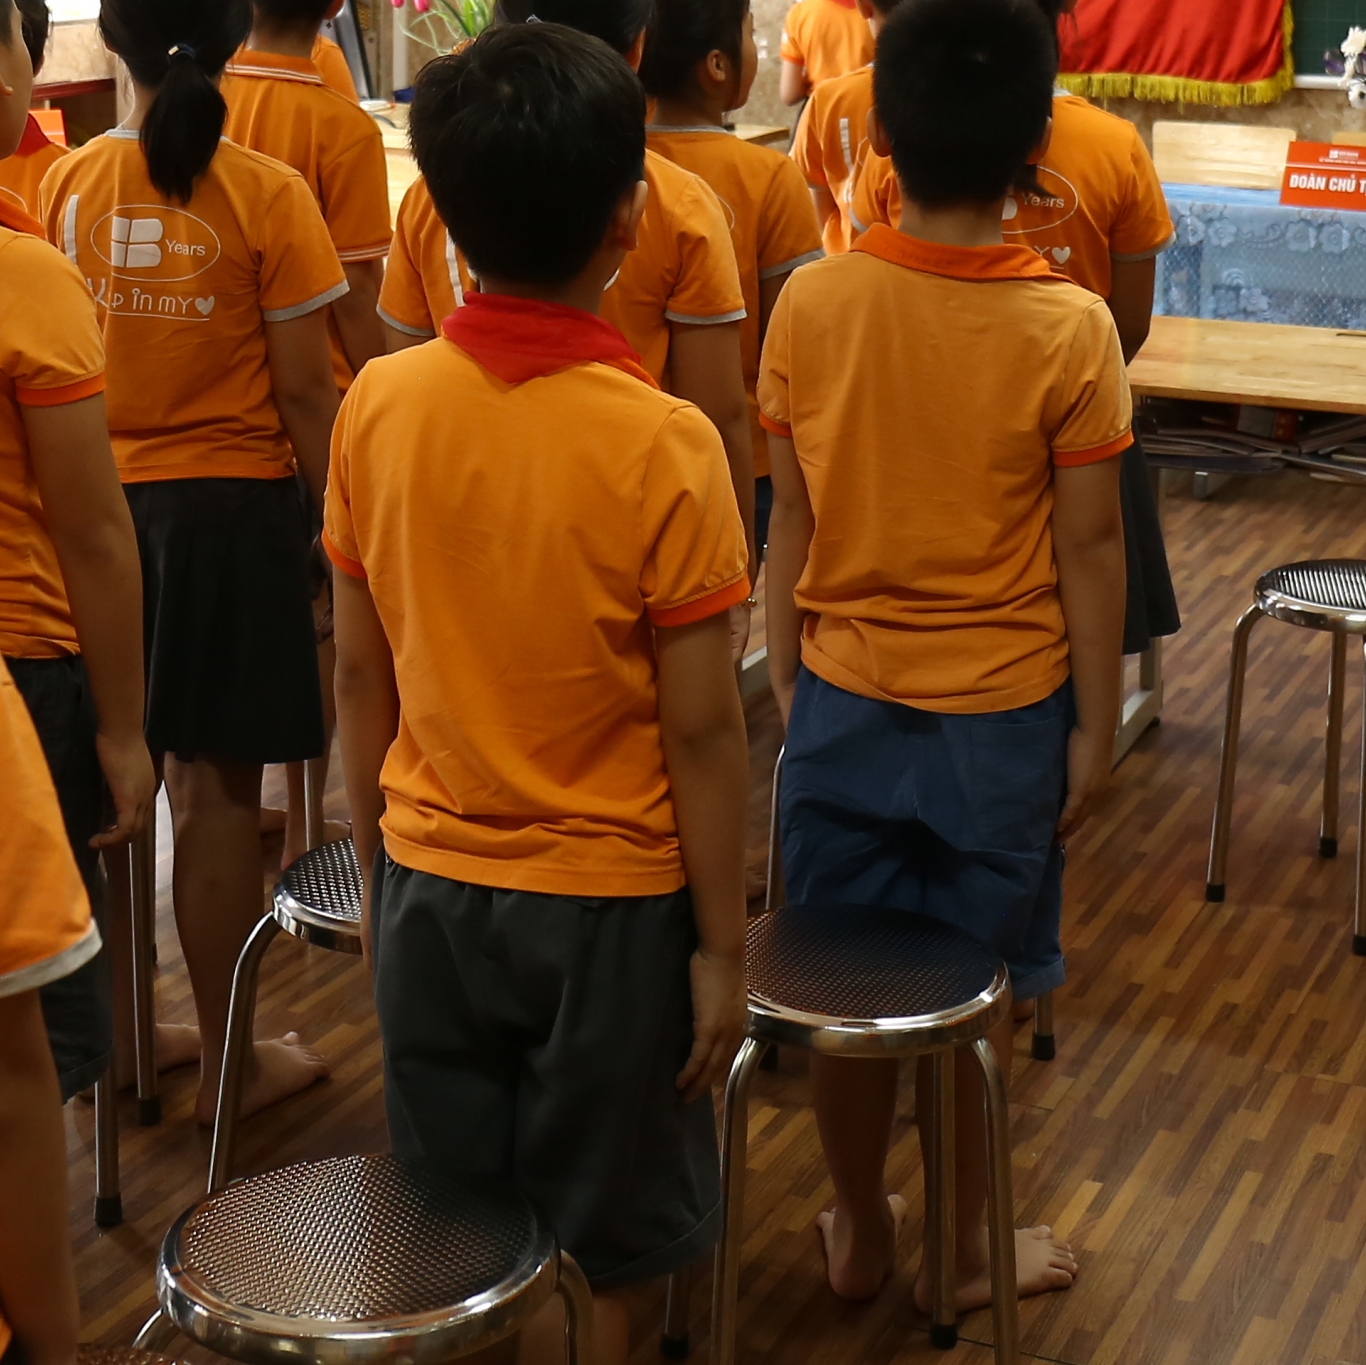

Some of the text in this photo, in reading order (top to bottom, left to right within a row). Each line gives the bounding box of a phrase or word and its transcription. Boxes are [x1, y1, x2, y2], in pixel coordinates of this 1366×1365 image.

[1289, 172, 1327, 191] ĐOÀN
[1328, 174, 1356, 193] CHỦ
[165, 238, 206, 256] Years
